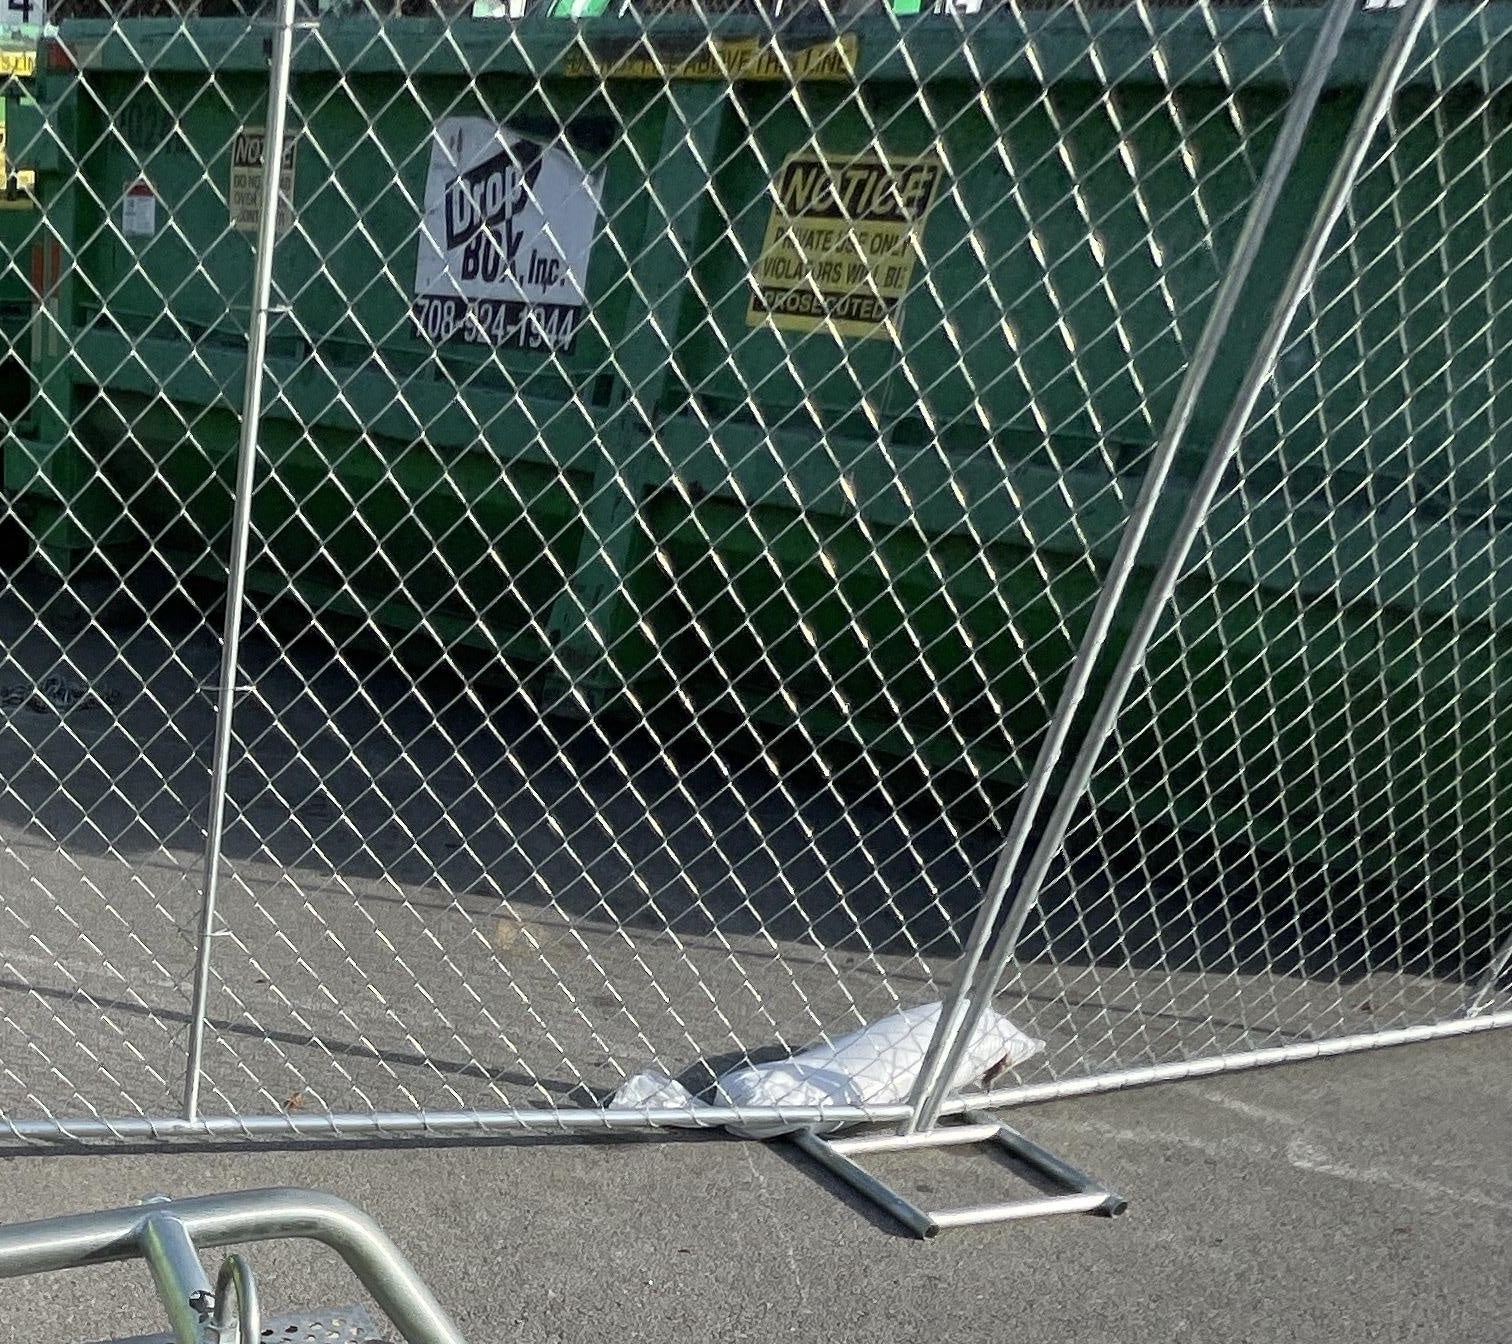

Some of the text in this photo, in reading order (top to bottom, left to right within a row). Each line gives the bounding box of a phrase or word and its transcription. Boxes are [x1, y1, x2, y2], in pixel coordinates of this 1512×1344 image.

[785, 166, 933, 217] NOTICE
[869, 231, 910, 257] ONLY
[527, 249, 567, 293] Inc.
[763, 256, 842, 284] VIOLAORS
[764, 290, 886, 319] PROSECUTED
[414, 297, 576, 351] 708-924-1944
